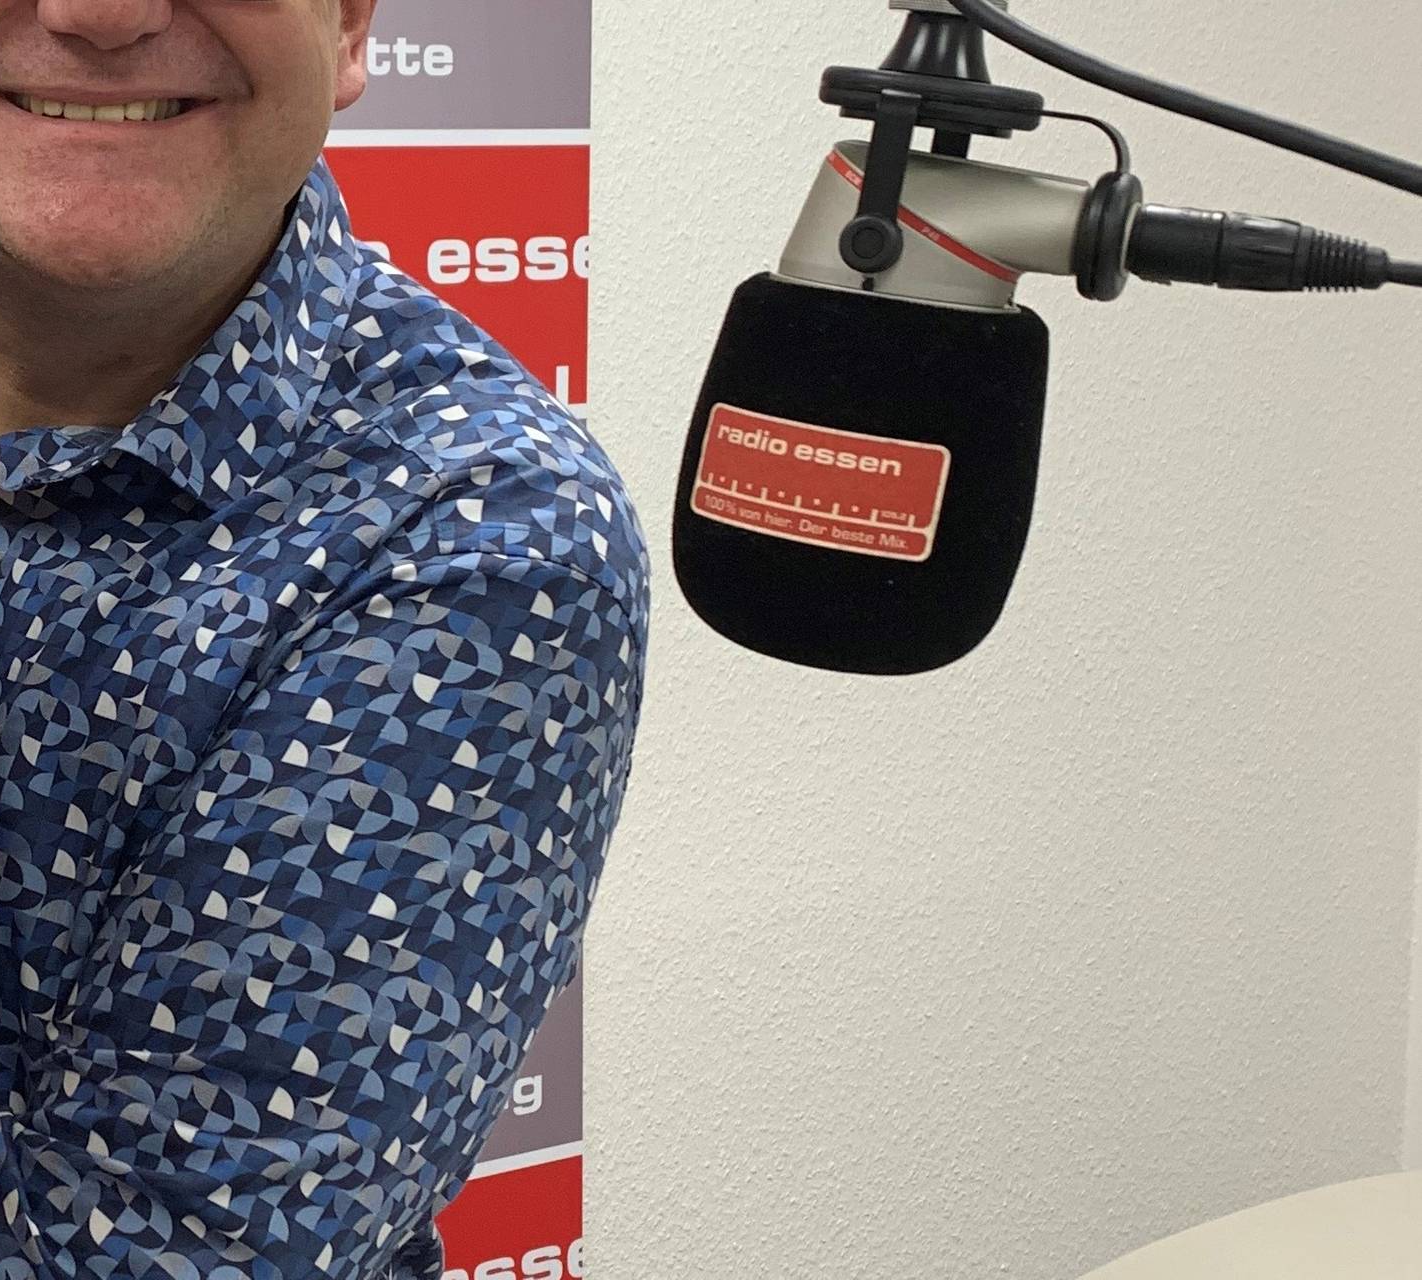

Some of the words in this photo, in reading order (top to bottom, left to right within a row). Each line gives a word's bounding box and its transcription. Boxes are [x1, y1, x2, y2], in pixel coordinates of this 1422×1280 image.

[717, 423, 788, 456] radio
[794, 443, 902, 477] essen
[740, 507, 762, 523] von
[798, 517, 828, 536] Der
[831, 520, 875, 545] beste
